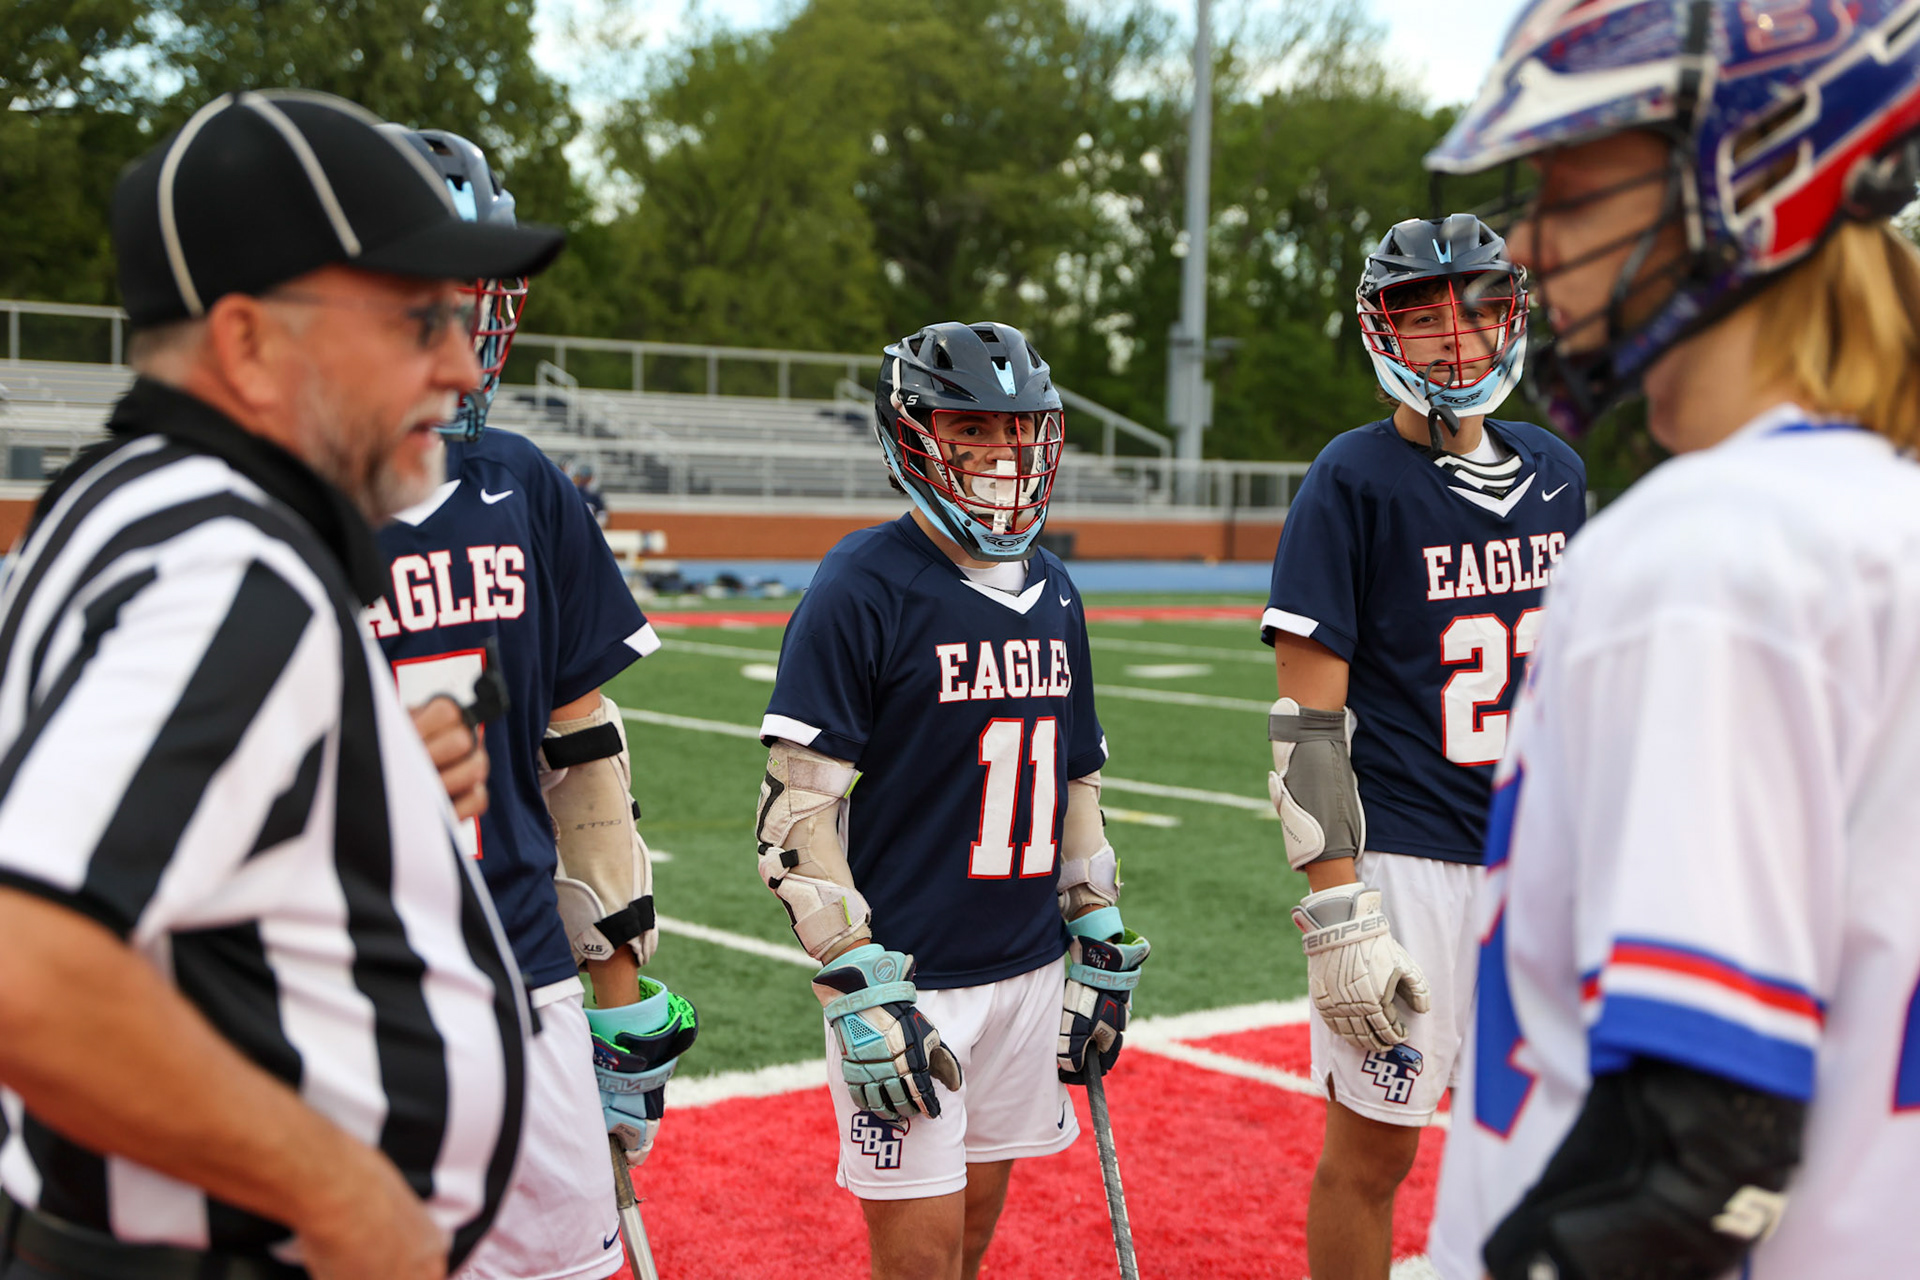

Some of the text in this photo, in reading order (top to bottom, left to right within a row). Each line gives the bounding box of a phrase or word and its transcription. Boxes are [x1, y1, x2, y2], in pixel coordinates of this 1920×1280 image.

[359, 545, 526, 638] AGLES
[935, 638, 1073, 704] EAGLES
[967, 715, 1058, 880] 11
[583, 943, 603, 953] STX
[1363, 1051, 1413, 1102] SBA
[851, 1114, 902, 1169] SBA
